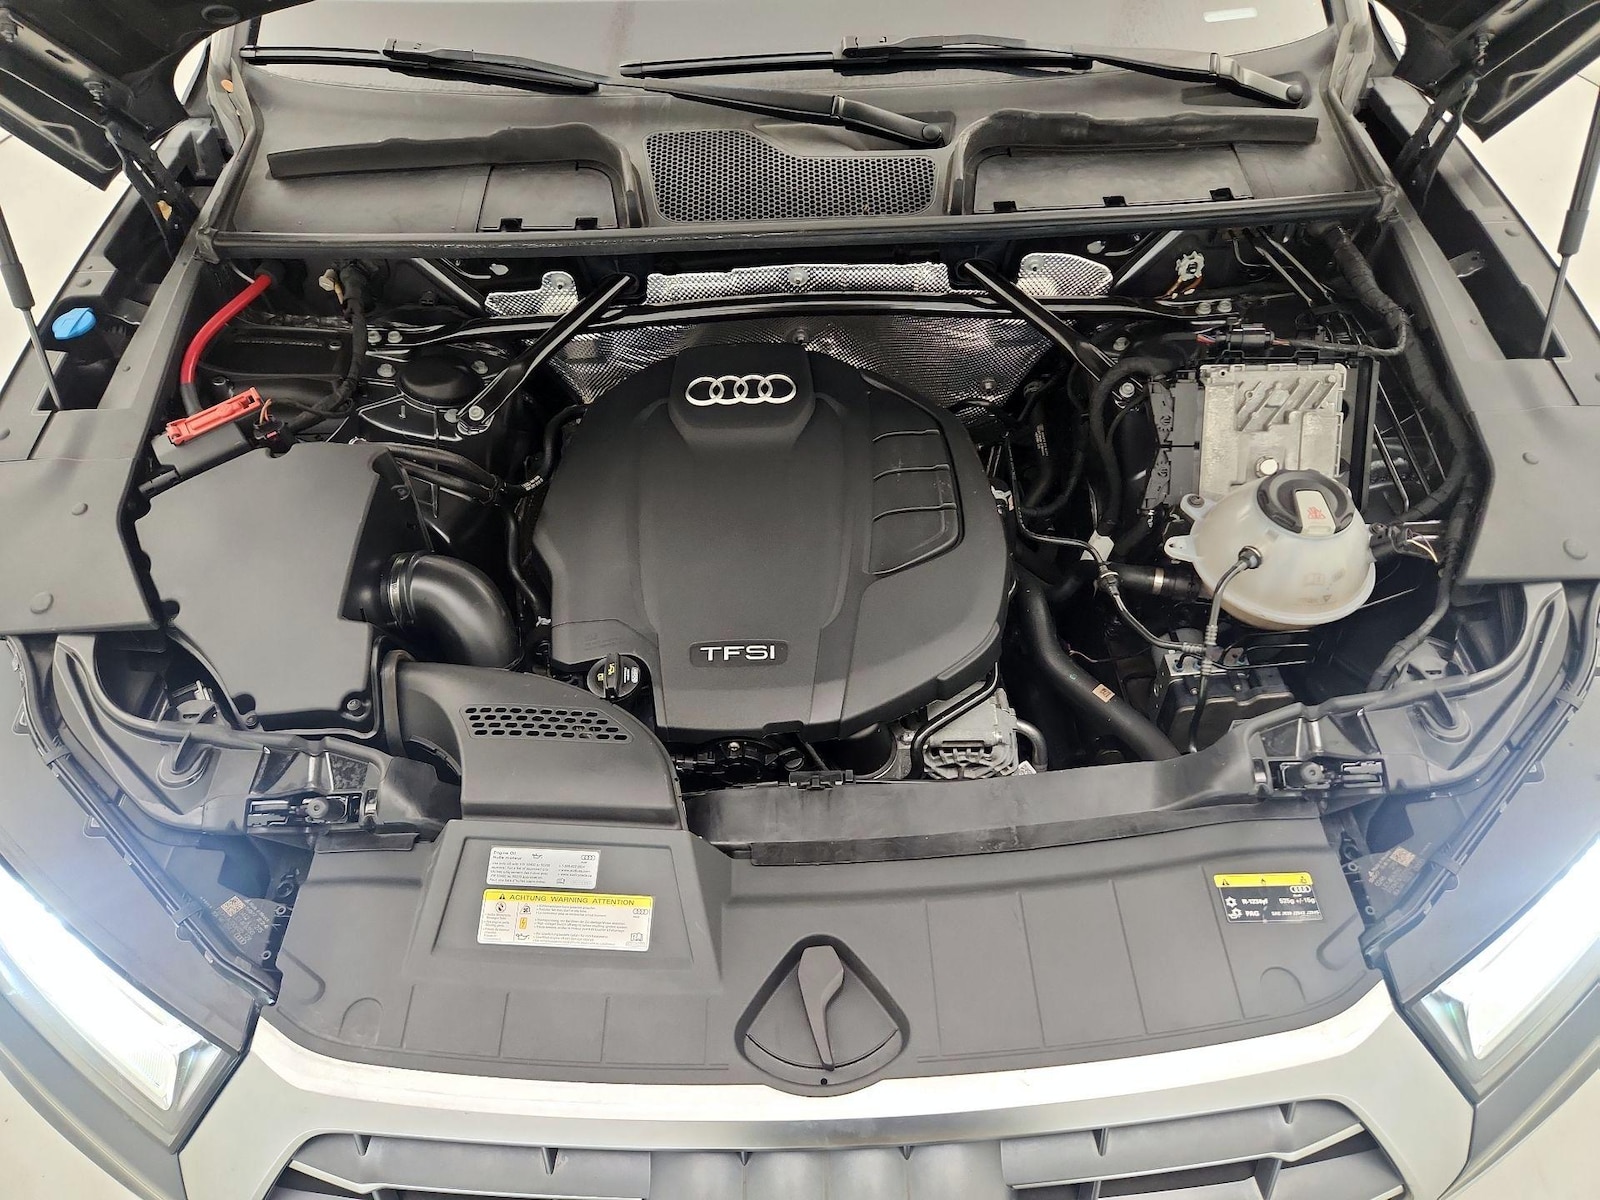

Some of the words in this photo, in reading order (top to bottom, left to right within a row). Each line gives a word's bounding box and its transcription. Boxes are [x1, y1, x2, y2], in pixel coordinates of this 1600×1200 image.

[700, 645, 775, 661] TFSI
[509, 894, 546, 902] ACHTUNG
[550, 896, 588, 904] WARNING
